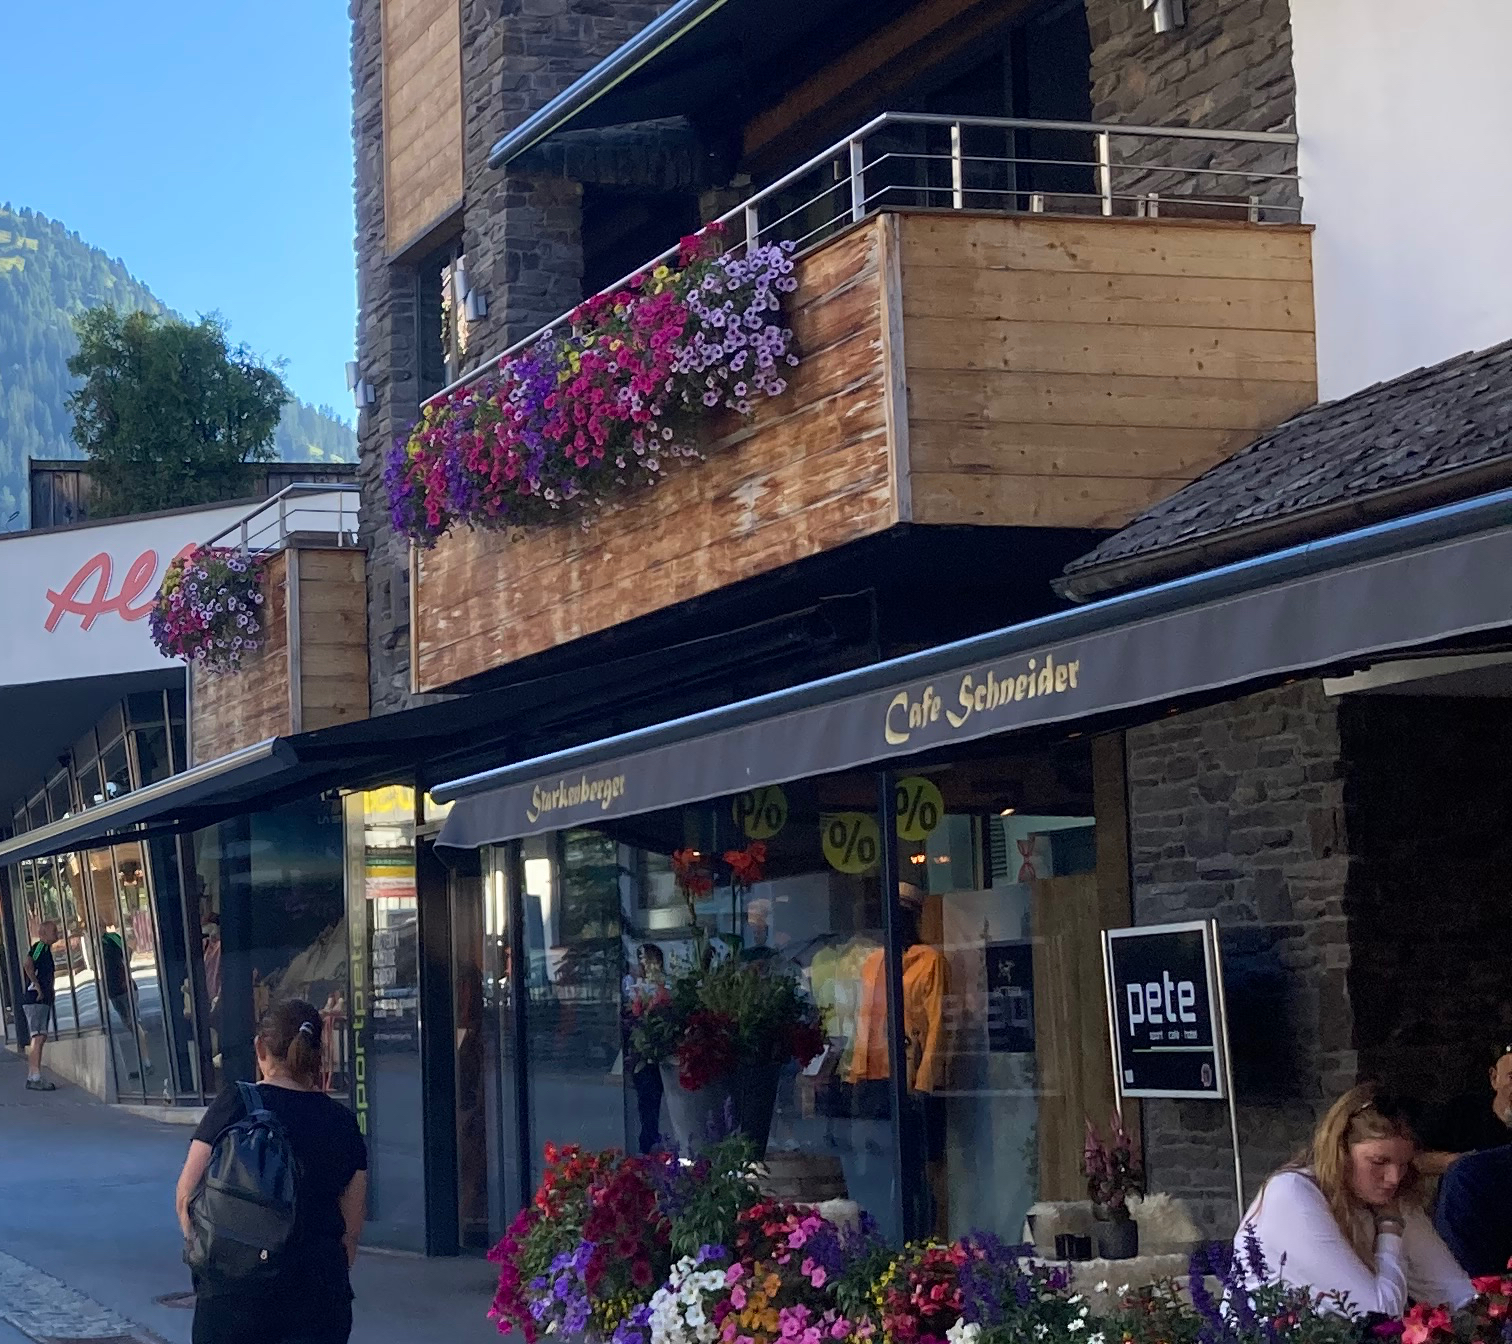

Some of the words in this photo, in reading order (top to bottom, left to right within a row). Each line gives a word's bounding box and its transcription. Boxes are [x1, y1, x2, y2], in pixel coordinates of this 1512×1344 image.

[44, 542, 197, 633] Al
[884, 686, 942, 745] Cafe
[946, 654, 1080, 728] Schneider
[526, 773, 626, 824] Starkenberger
[1126, 970, 1197, 1037] pete
